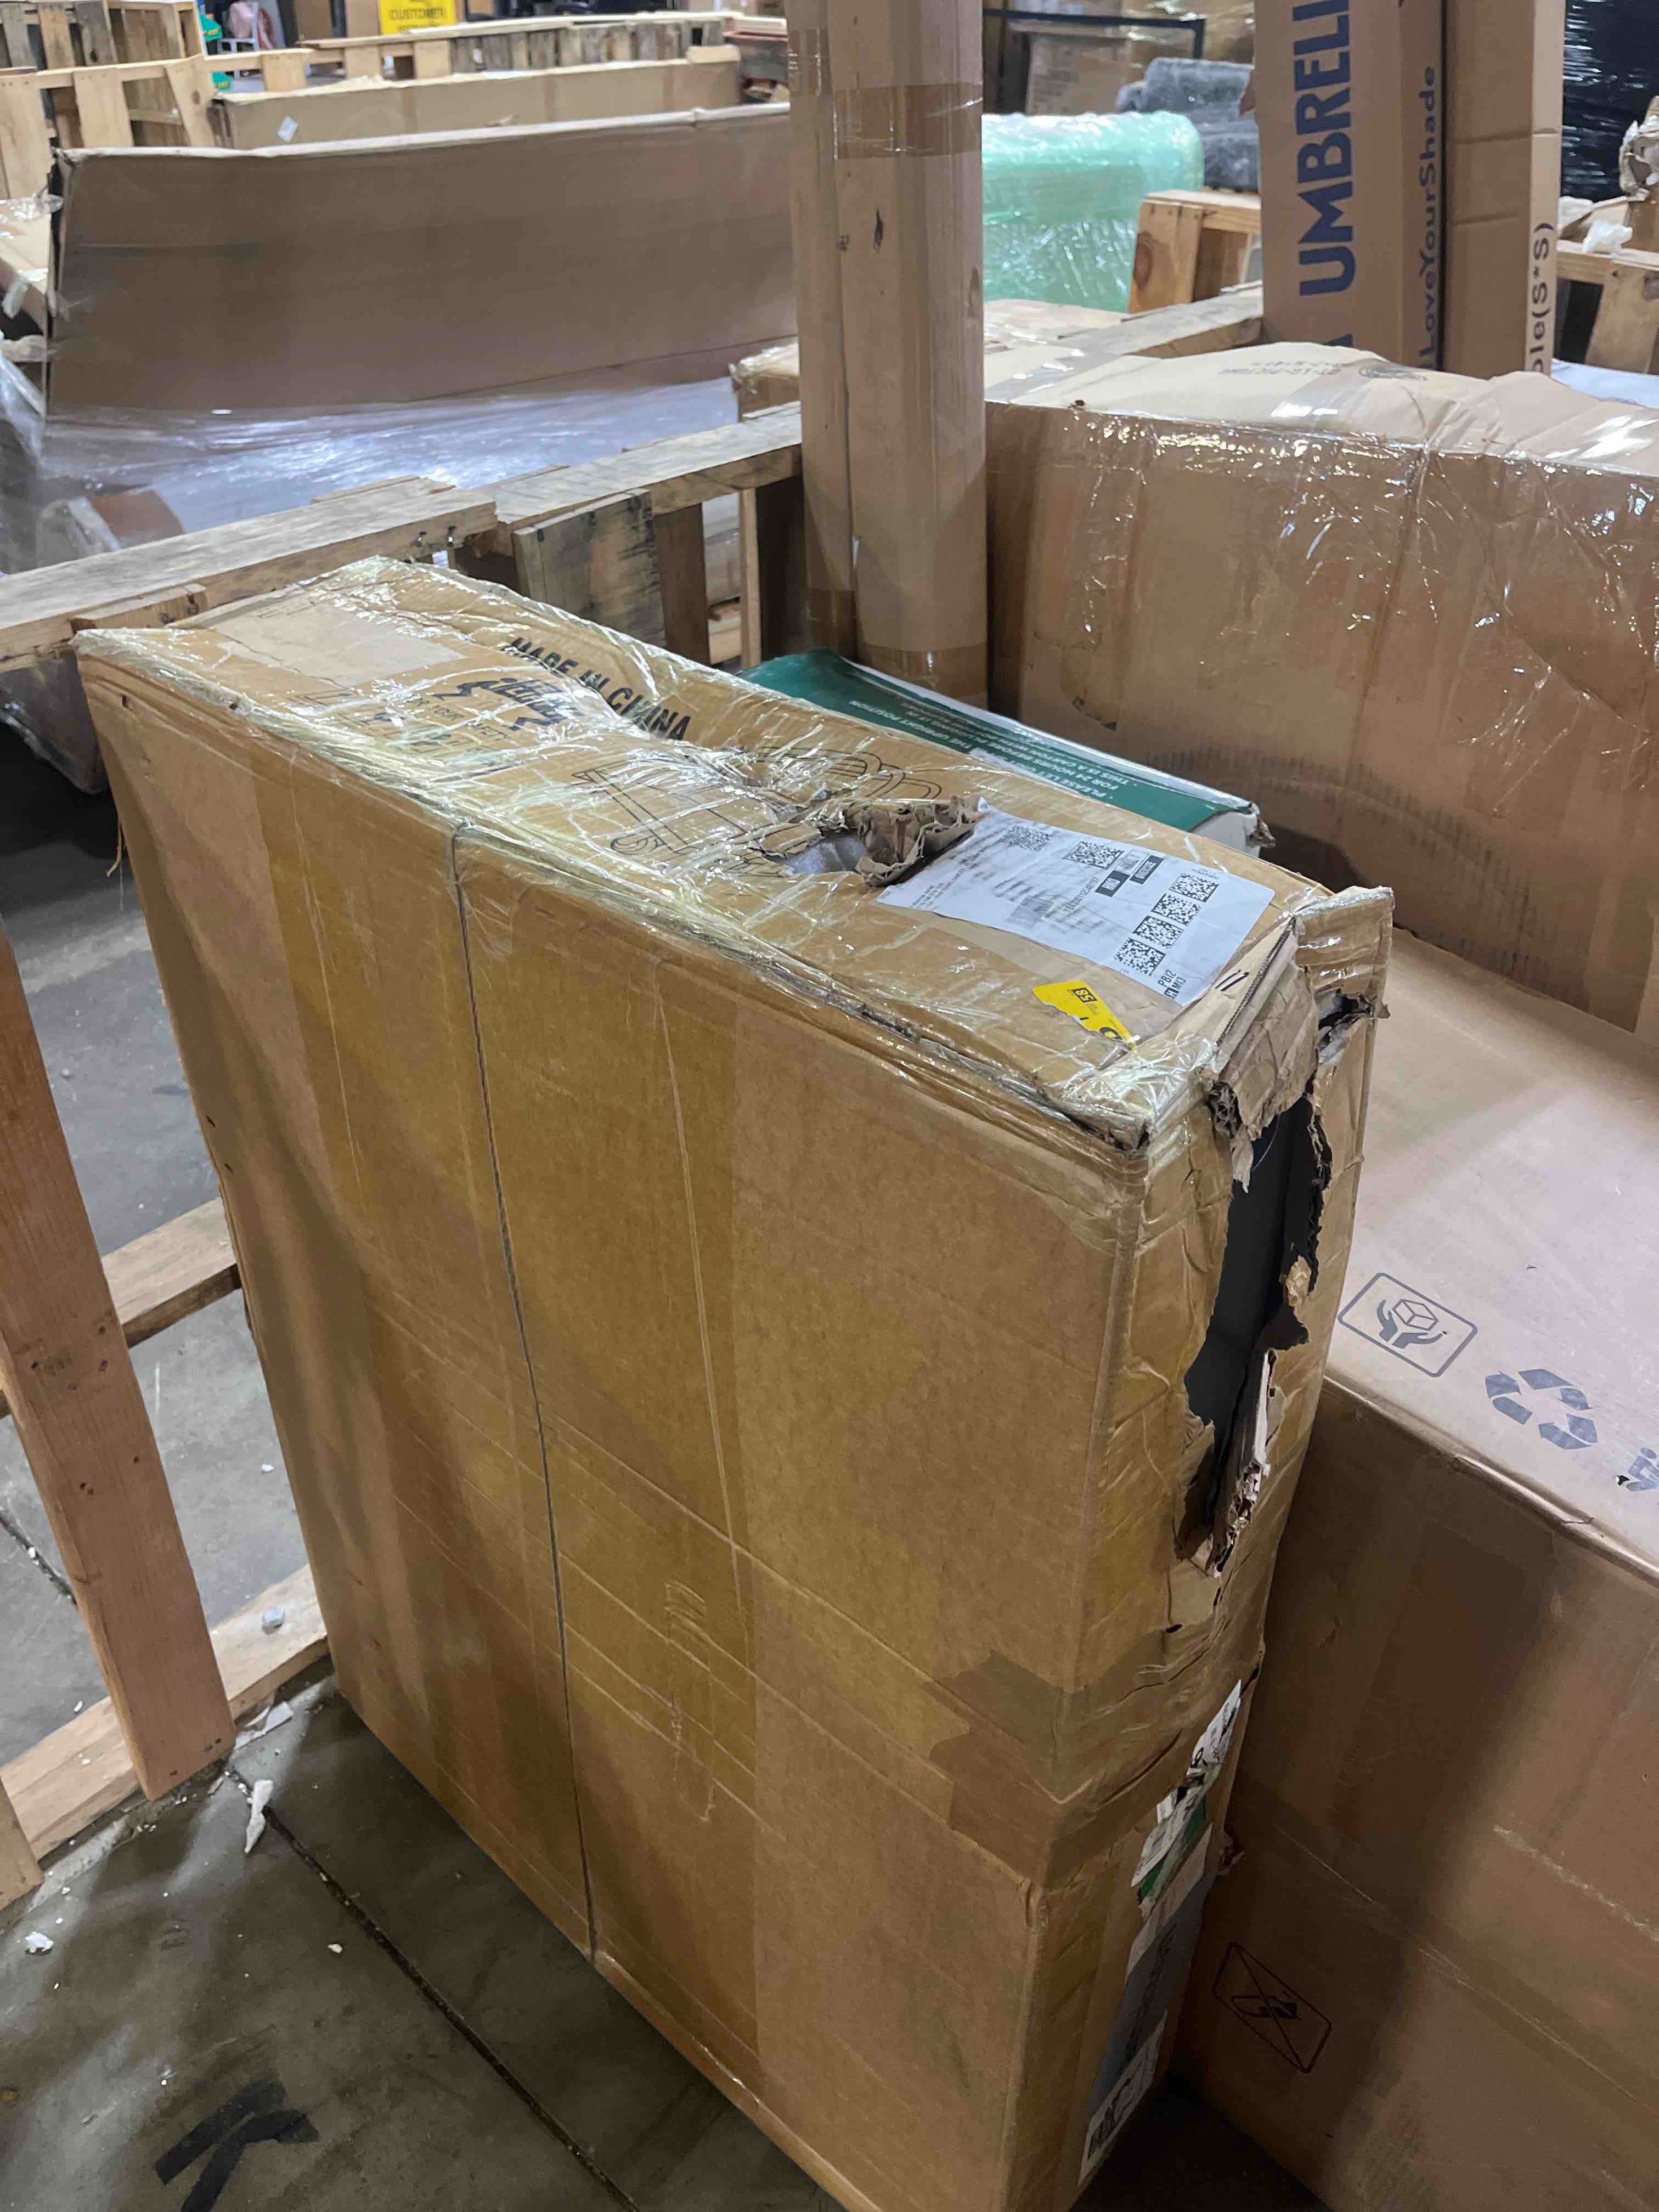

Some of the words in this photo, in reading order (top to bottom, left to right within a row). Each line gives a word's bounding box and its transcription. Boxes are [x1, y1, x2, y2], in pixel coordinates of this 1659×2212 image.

[1032, 759, 1076, 776] HOURS
[1060, 779, 1107, 797] PLEASE
[1091, 778, 1119, 791] FOR
